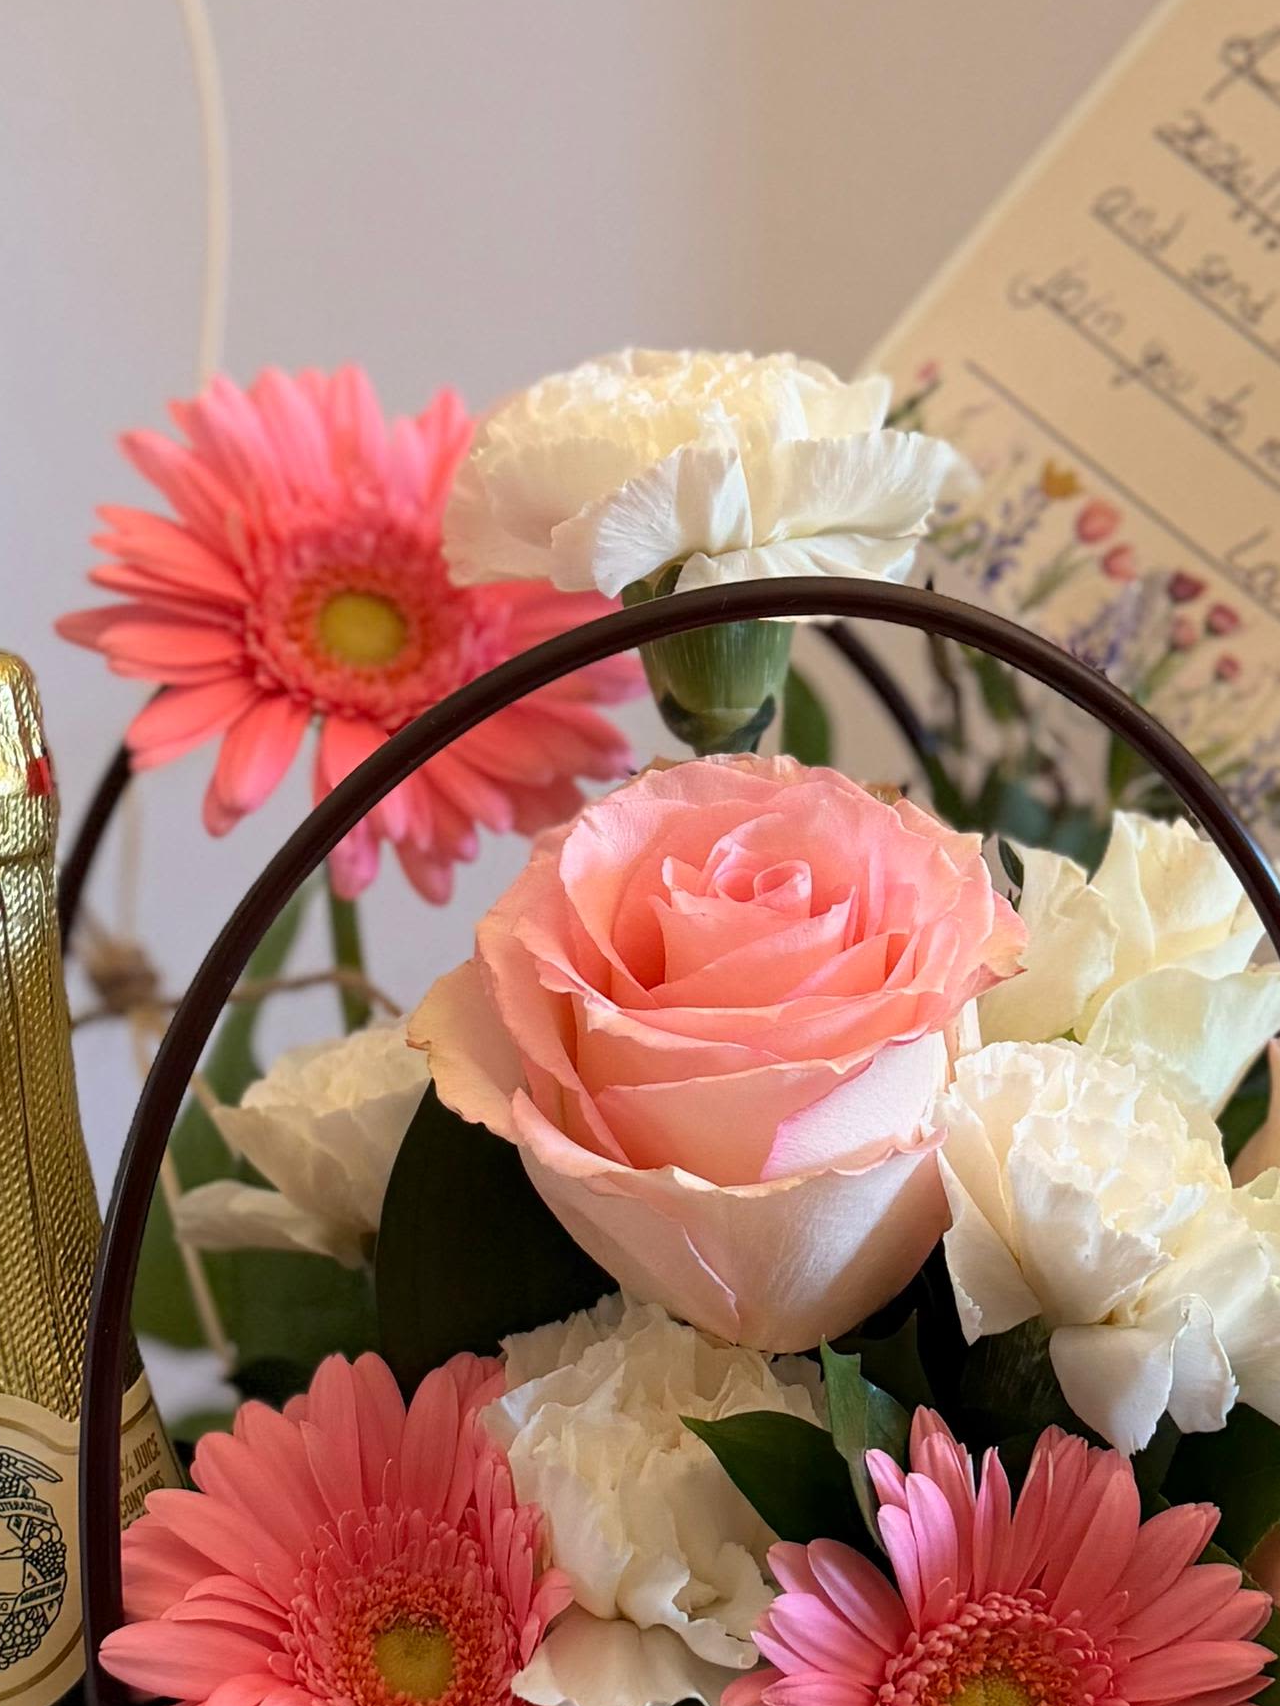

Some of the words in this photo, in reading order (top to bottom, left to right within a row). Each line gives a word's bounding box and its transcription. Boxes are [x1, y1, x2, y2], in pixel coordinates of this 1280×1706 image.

[1093, 187, 1188, 255] and
[1206, 384, 1254, 440] to
[132, 1431, 161, 1475] JUICE
